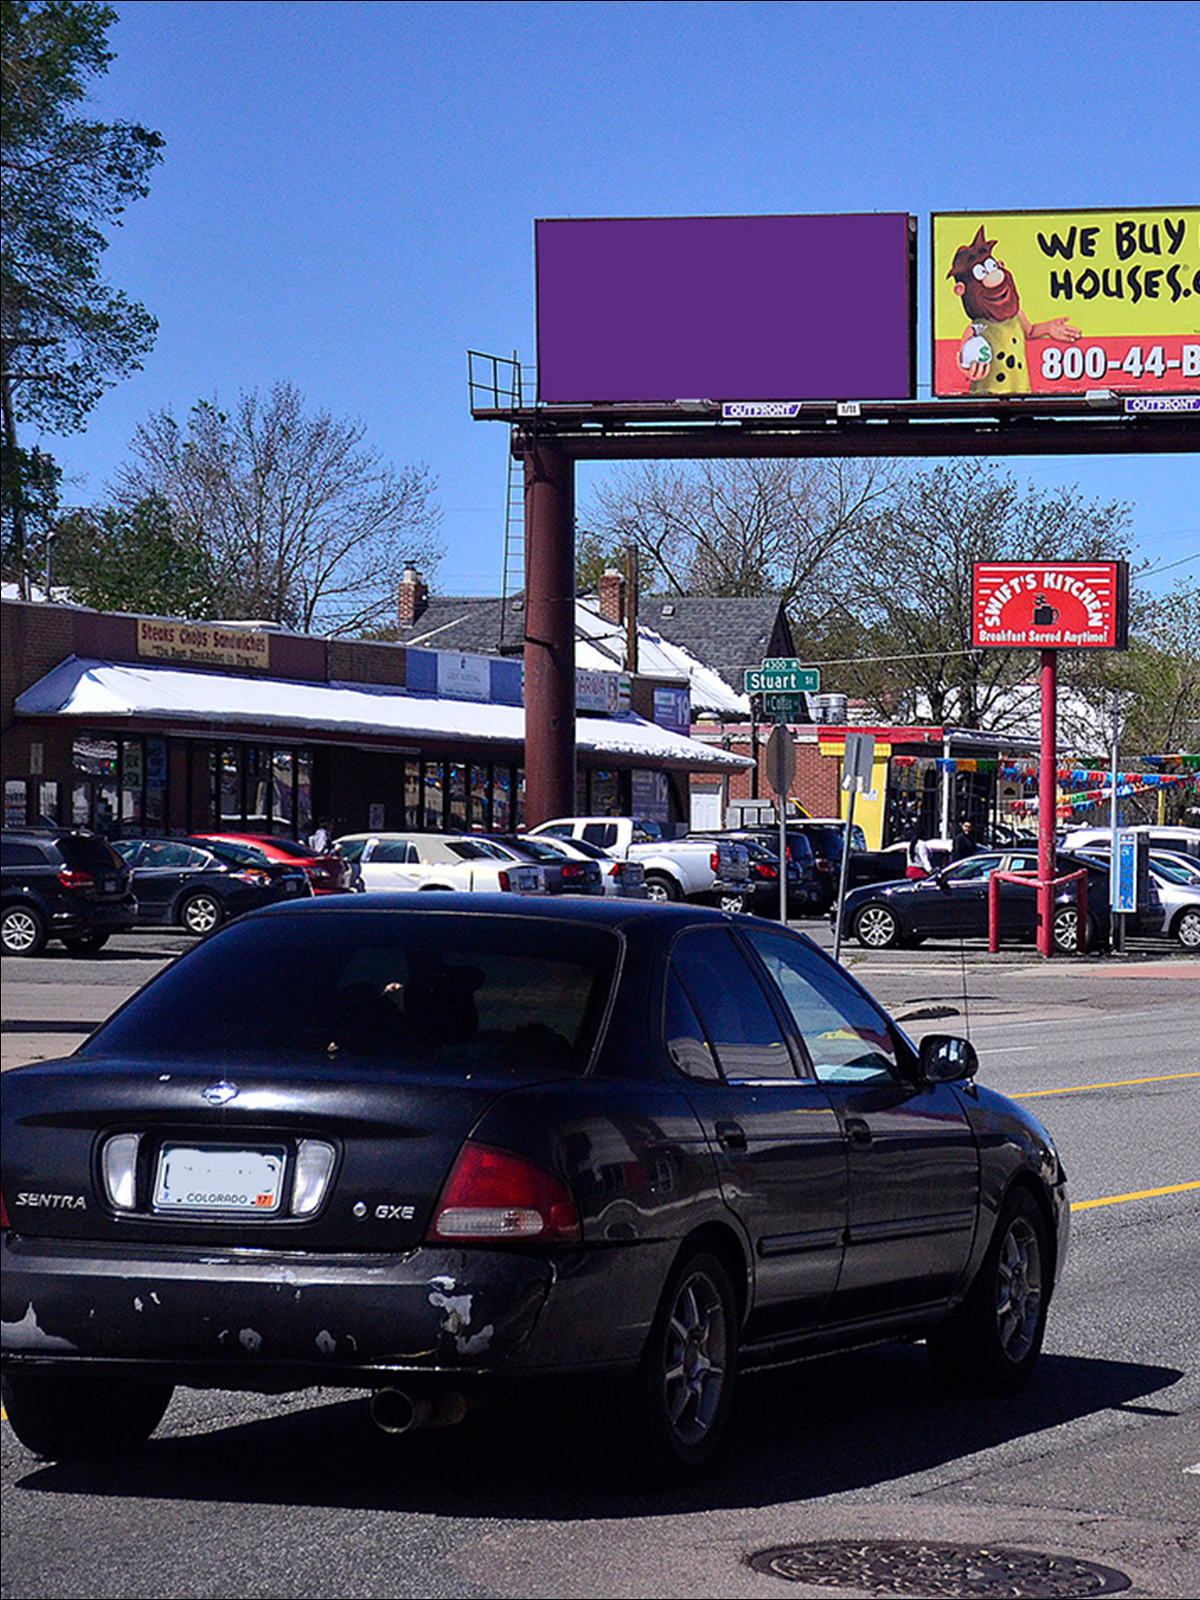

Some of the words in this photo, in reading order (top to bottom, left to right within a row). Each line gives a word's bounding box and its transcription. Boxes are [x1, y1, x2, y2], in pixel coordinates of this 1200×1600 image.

[1037, 226, 1100, 260] WE
[1115, 218, 1185, 260] BUY
[729, 403, 794, 416] OUTFRONT
[1133, 398, 1196, 411] OUTFRONT
[984, 573, 1037, 627] SWIFT'S
[1043, 572, 1103, 627] KITCHEN
[979, 629, 1026, 642] Breakfast
[1028, 629, 1061, 642] Served
[1064, 630, 1107, 645] Anytime!
[751, 673, 796, 689] Stuart
[15, 1192, 87, 1210] SENTRA
[186, 1193, 247, 1205] COLORADO
[374, 1204, 415, 1219] GXE
